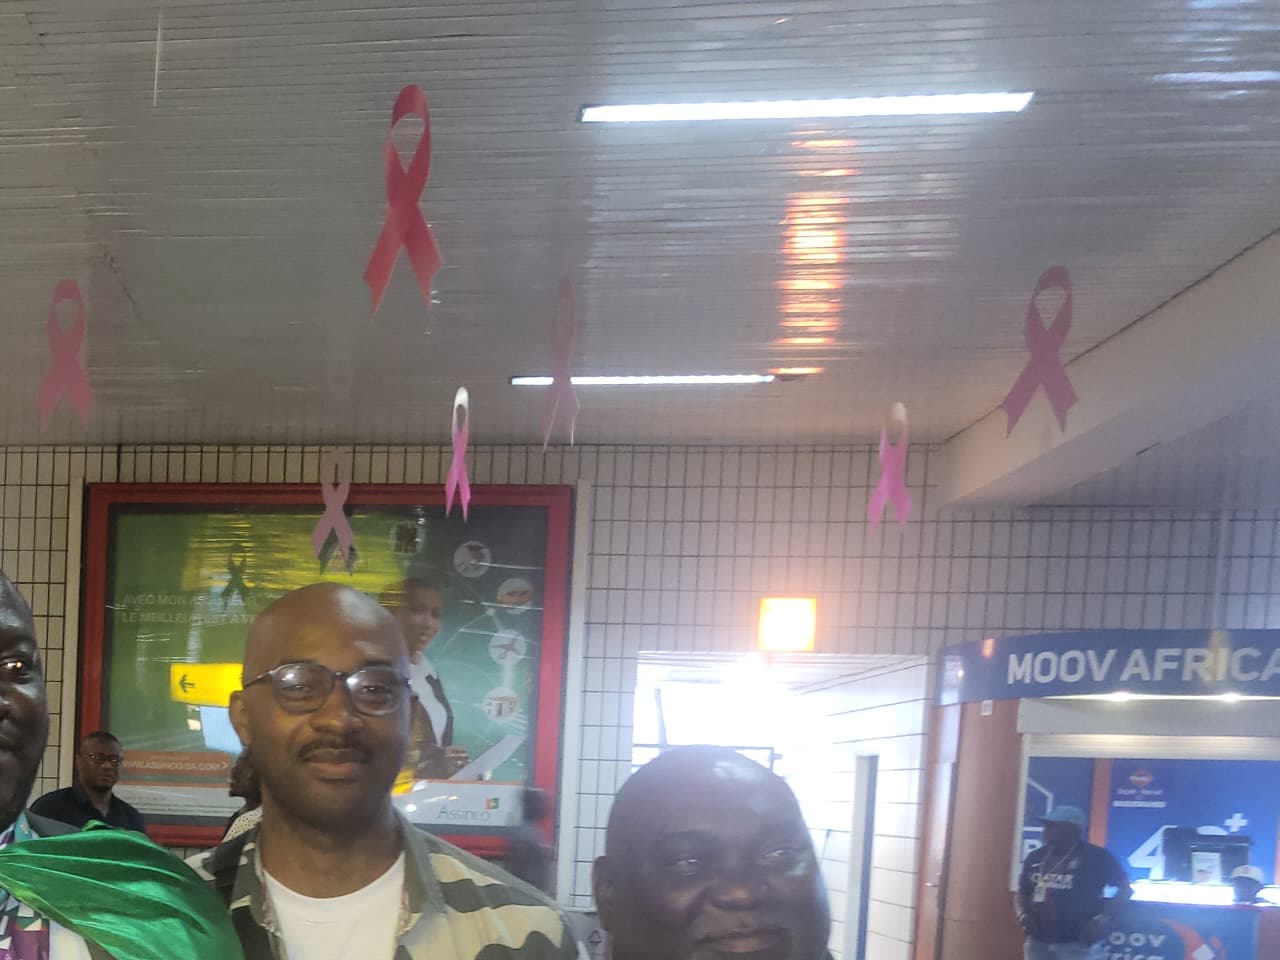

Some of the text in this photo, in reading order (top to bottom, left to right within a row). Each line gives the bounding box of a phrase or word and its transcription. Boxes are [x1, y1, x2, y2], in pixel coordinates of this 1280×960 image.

[1007, 647, 1280, 685] MOOV AFRICA
[1109, 932, 1168, 948] oov
